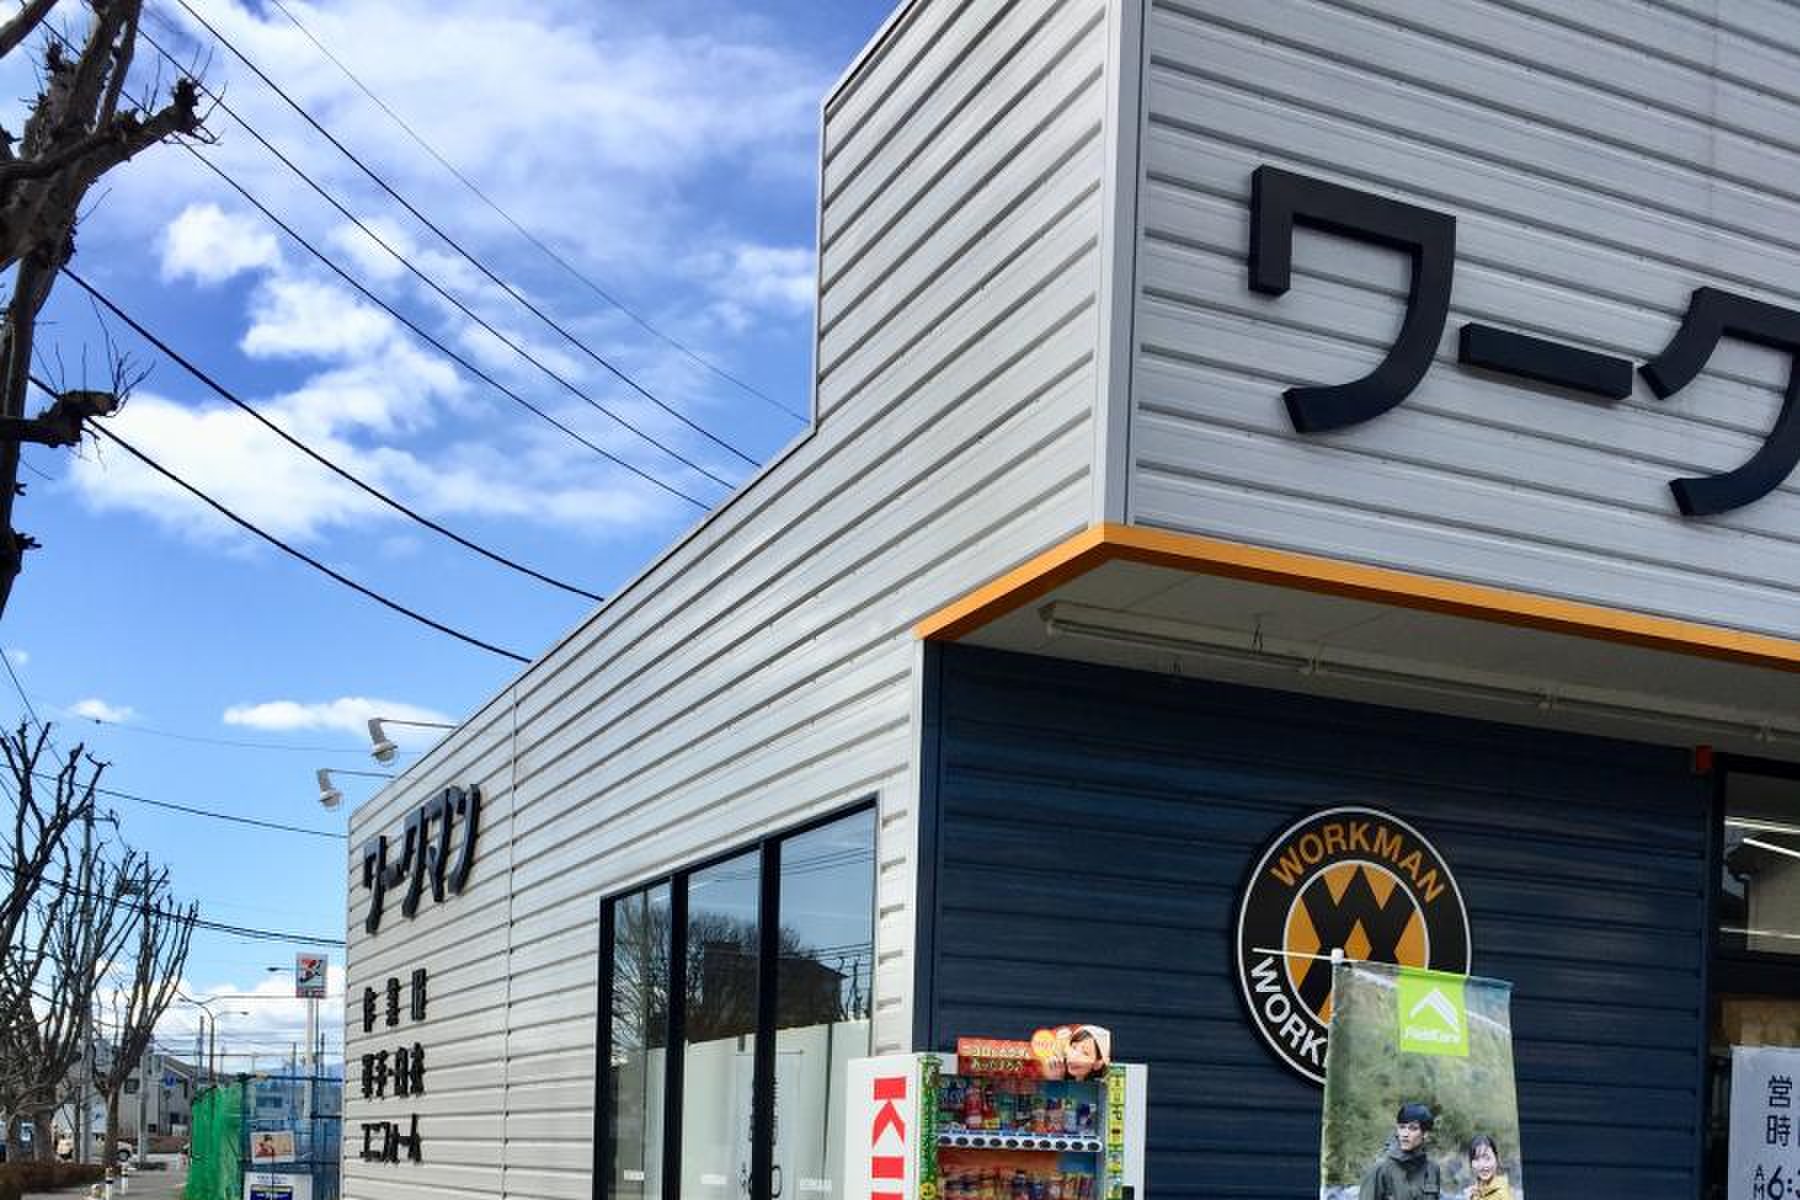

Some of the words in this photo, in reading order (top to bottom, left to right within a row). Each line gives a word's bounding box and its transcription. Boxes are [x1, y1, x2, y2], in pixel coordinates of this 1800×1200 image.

[1270, 821, 1444, 902] WORKMAN
[1251, 956, 1328, 1069] WORK
[1768, 1075, 1800, 1108] 営
[1766, 1115, 1800, 1148] 時
